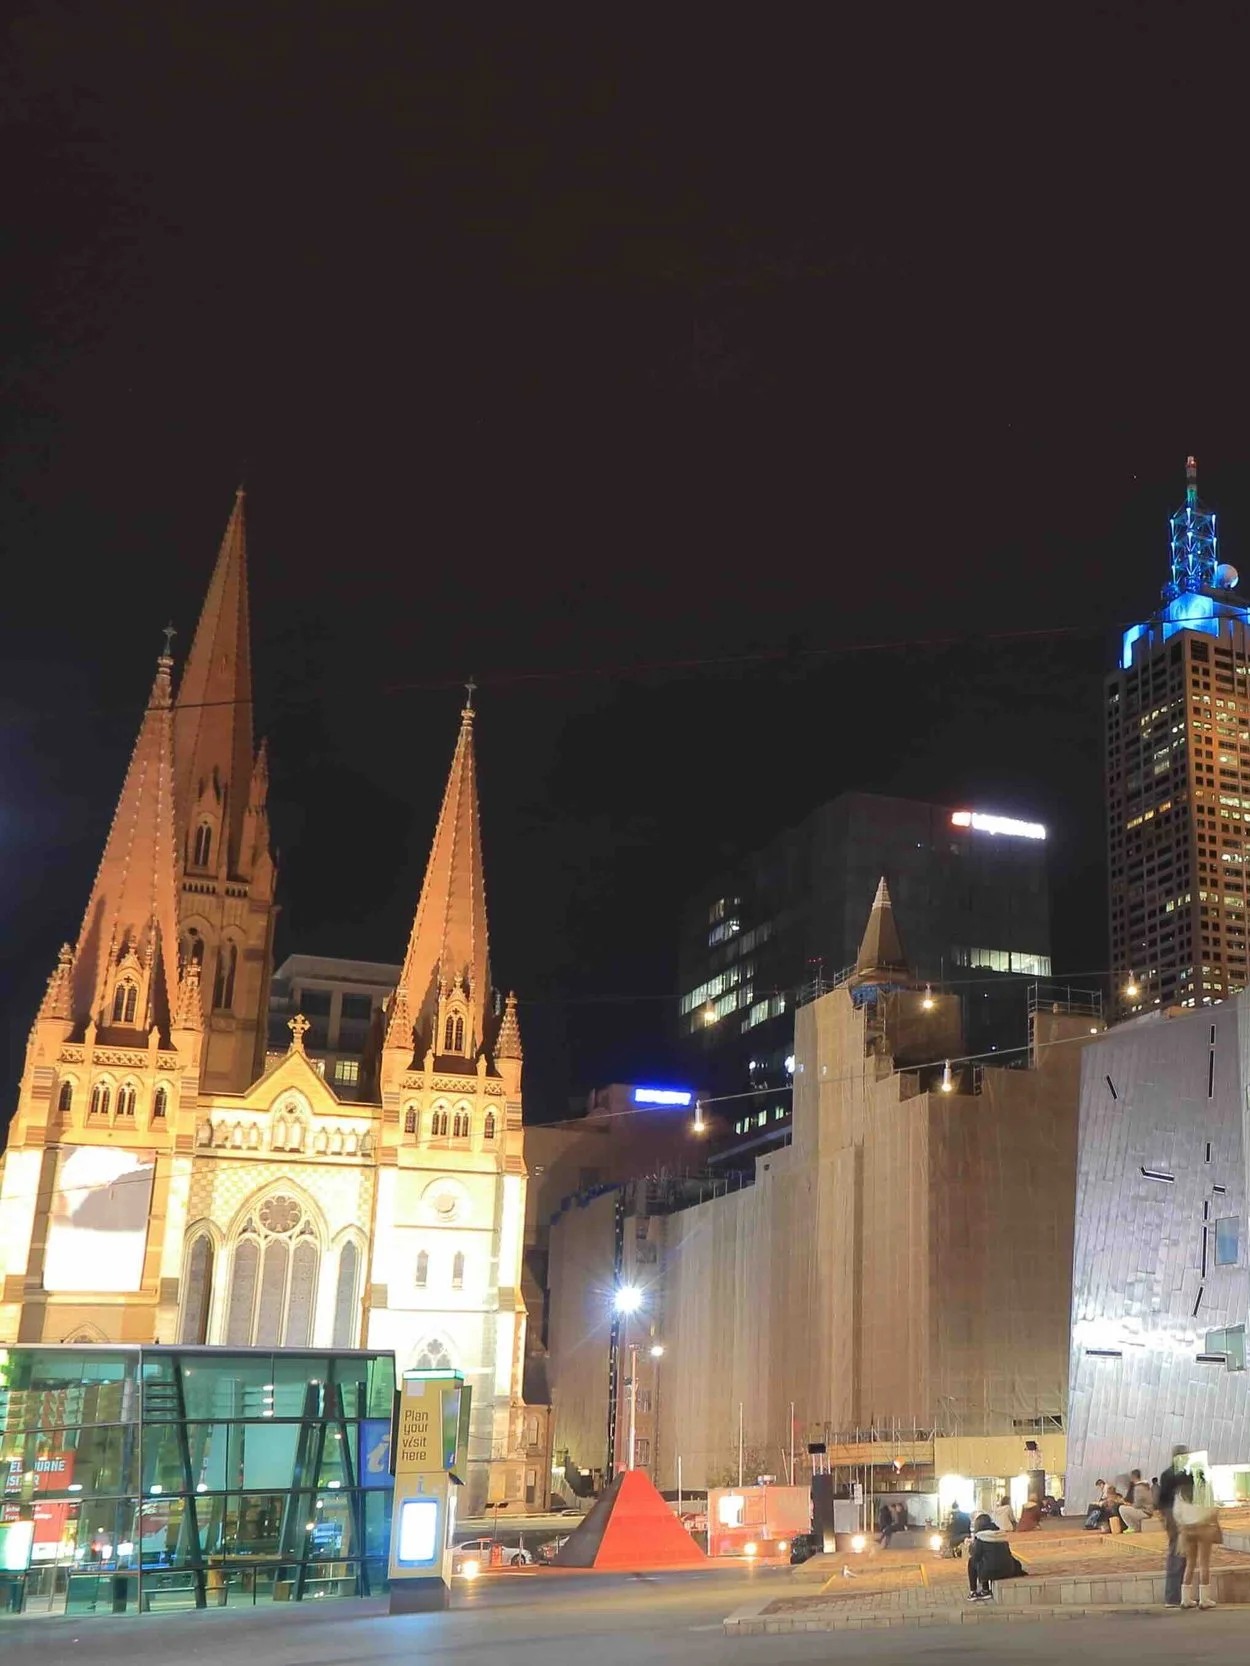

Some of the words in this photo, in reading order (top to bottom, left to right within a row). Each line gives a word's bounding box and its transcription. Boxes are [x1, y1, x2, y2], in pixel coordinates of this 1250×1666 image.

[404, 1410, 429, 1421] Plan
[403, 1423, 429, 1435] your
[402, 1437, 427, 1448] visit
[401, 1449, 427, 1461] here
[10, 1461, 65, 1473] ELURNE
